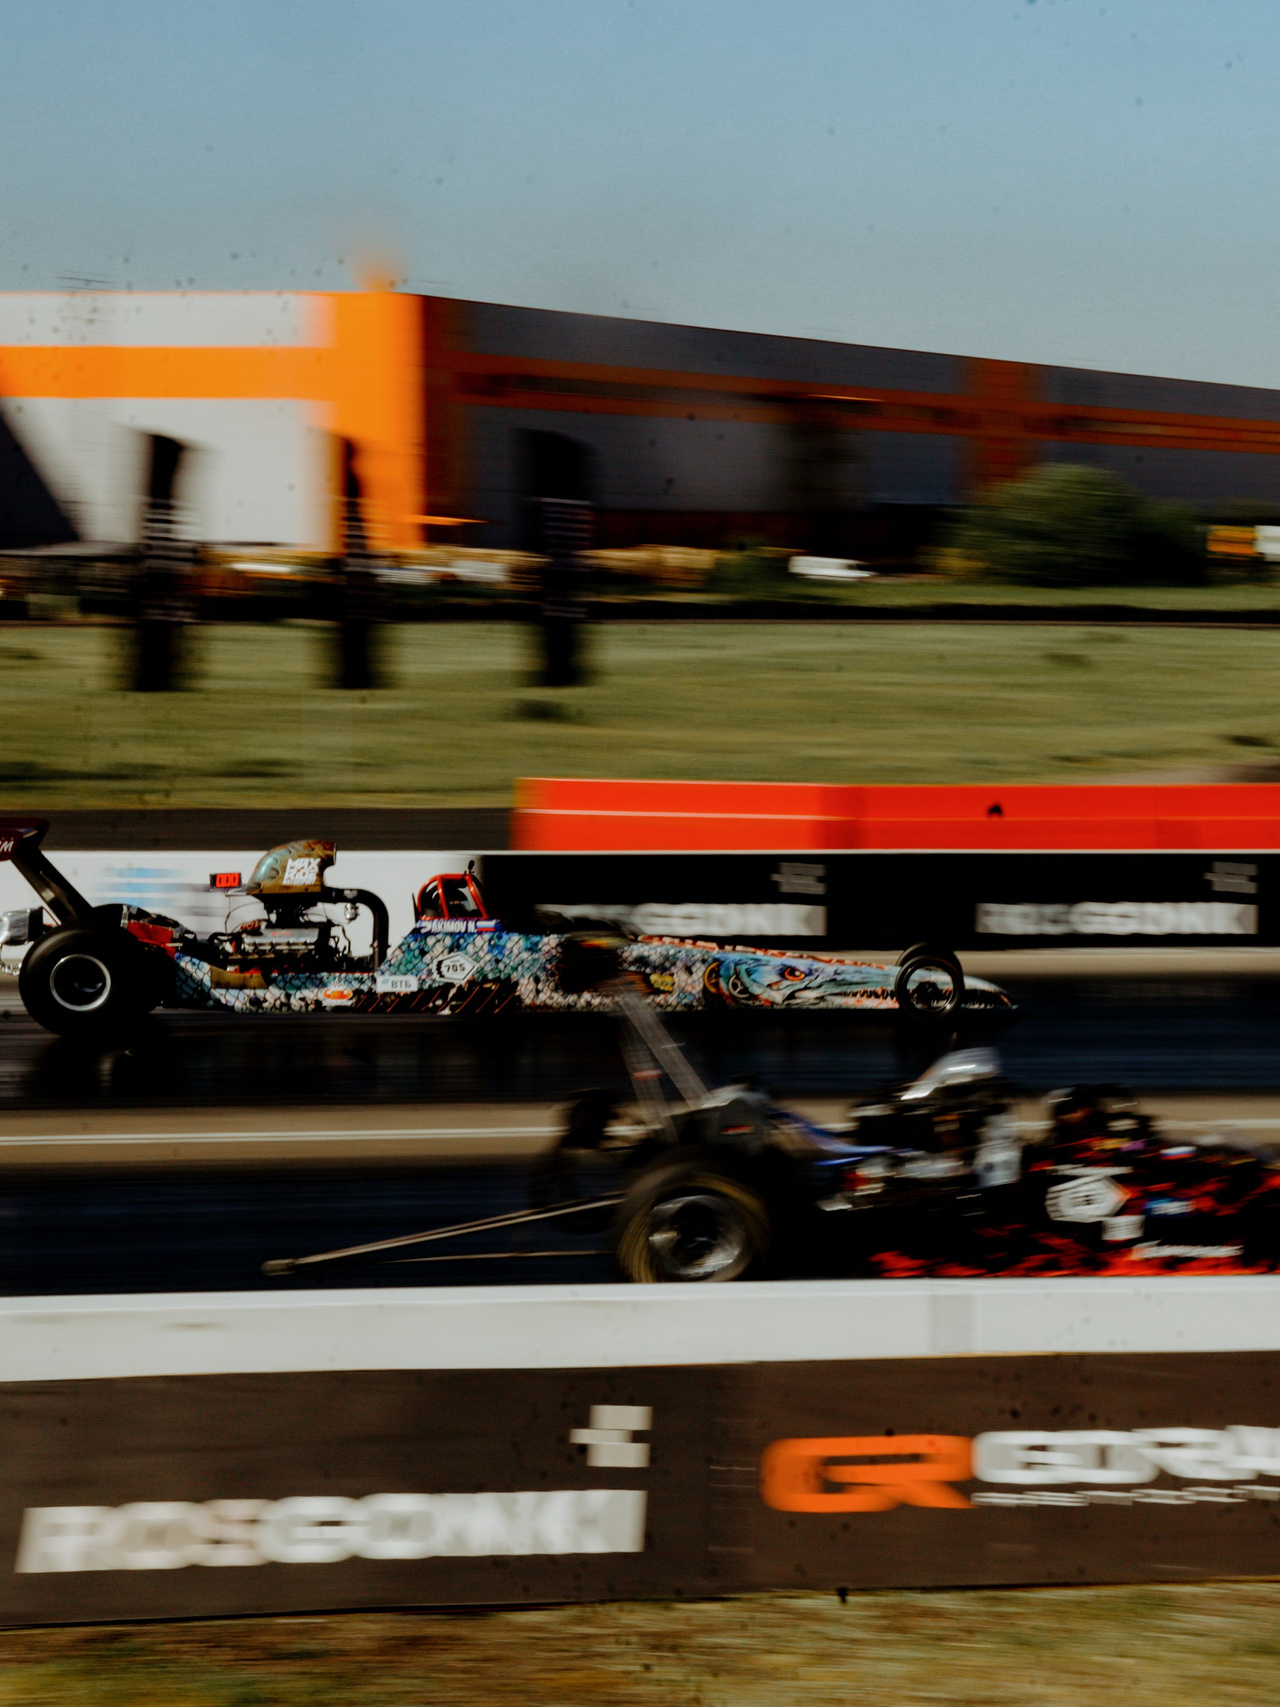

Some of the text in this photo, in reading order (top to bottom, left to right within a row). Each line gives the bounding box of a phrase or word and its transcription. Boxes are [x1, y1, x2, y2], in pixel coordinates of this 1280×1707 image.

[286, 857, 321, 870] MAX
[431, 919, 467, 933] AKIMOV
[445, 962, 466, 972] 705
